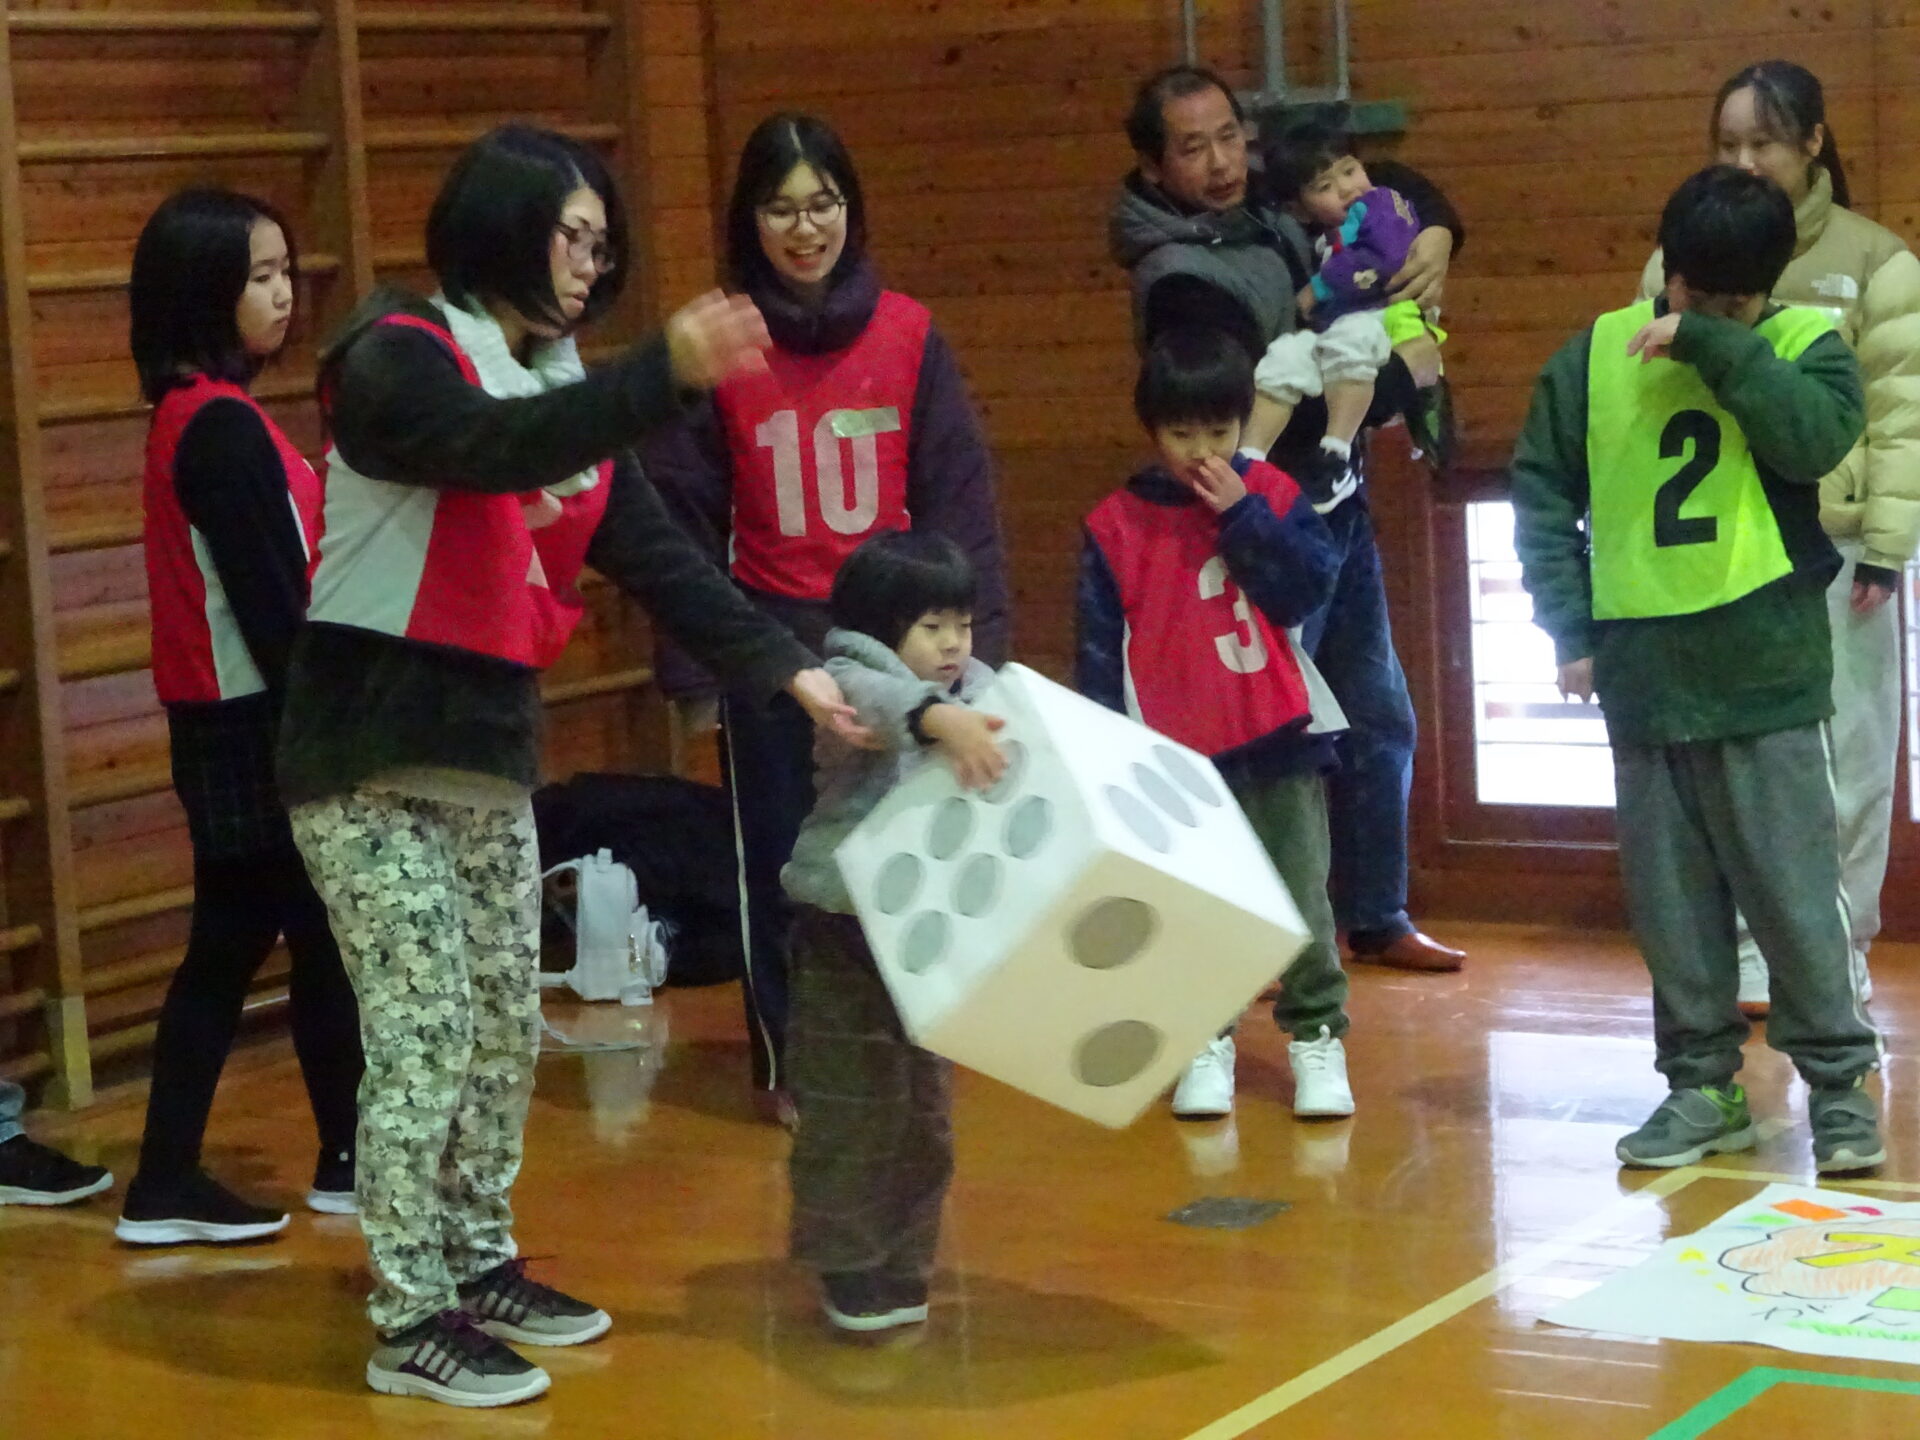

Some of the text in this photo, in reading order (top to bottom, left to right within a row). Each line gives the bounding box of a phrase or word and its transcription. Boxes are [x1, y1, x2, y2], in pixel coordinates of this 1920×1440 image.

[755, 408, 880, 537] 10
[1653, 409, 1722, 548] 2
[1198, 555, 1269, 674] 3
